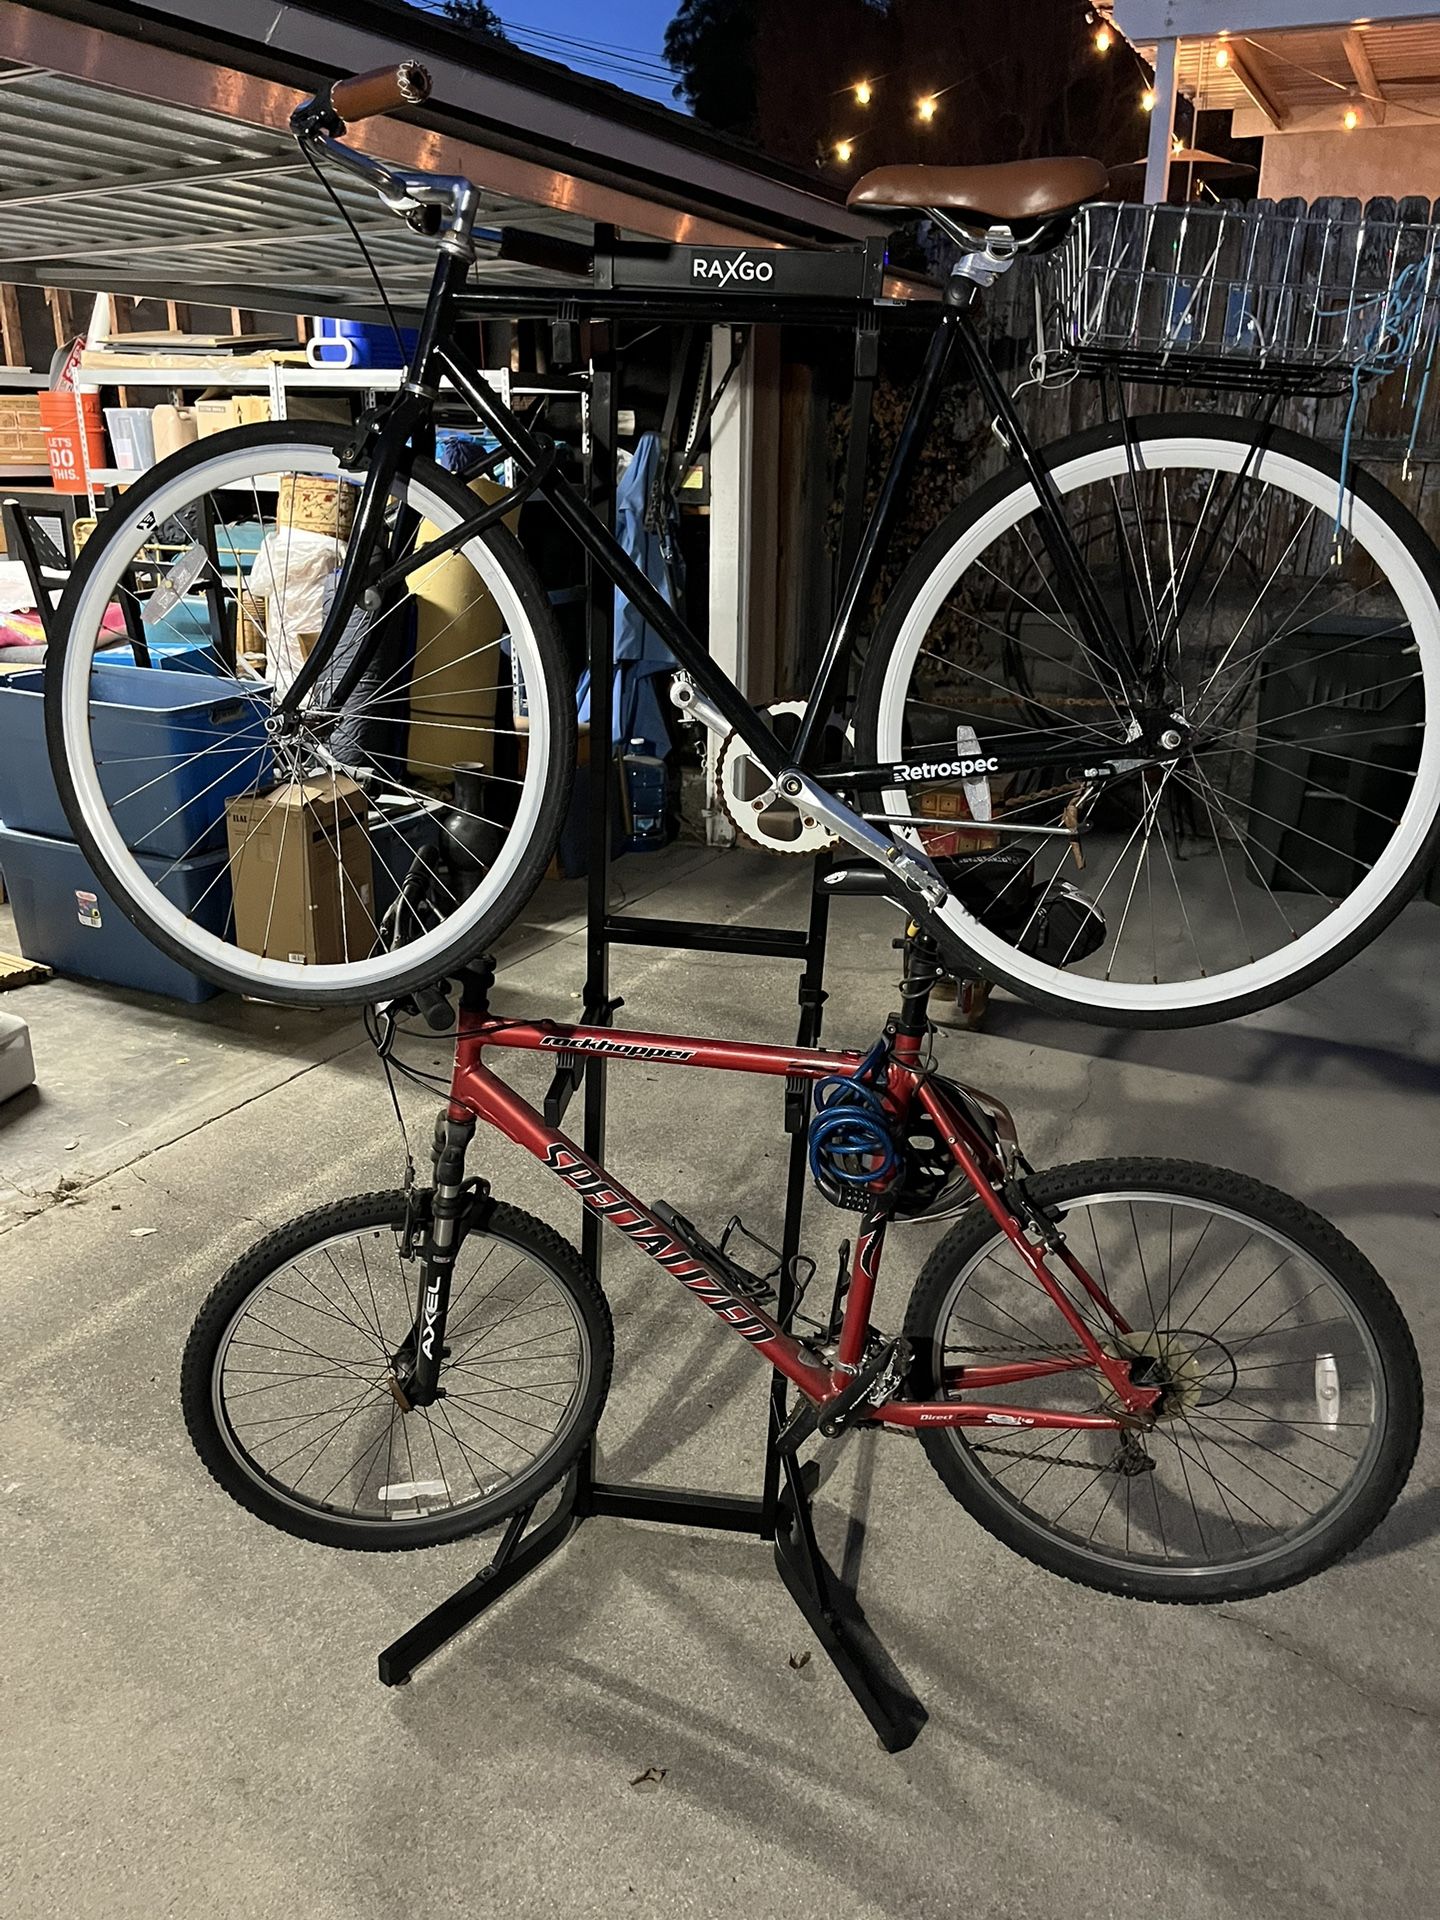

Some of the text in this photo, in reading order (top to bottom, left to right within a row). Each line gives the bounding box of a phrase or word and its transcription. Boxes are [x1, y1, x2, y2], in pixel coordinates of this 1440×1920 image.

[692, 251, 774, 288] RAXGO
[48, 437, 72, 448] LET'S
[50, 449, 75, 468] DO
[52, 468, 80, 480] THIS.
[893, 757, 999, 782] Retrospec
[539, 1035, 698, 1060] rockhopper
[543, 1142, 777, 1344] SPECIALIZED
[422, 1276, 441, 1360] AXEL
[920, 1413, 953, 1421] Direct
